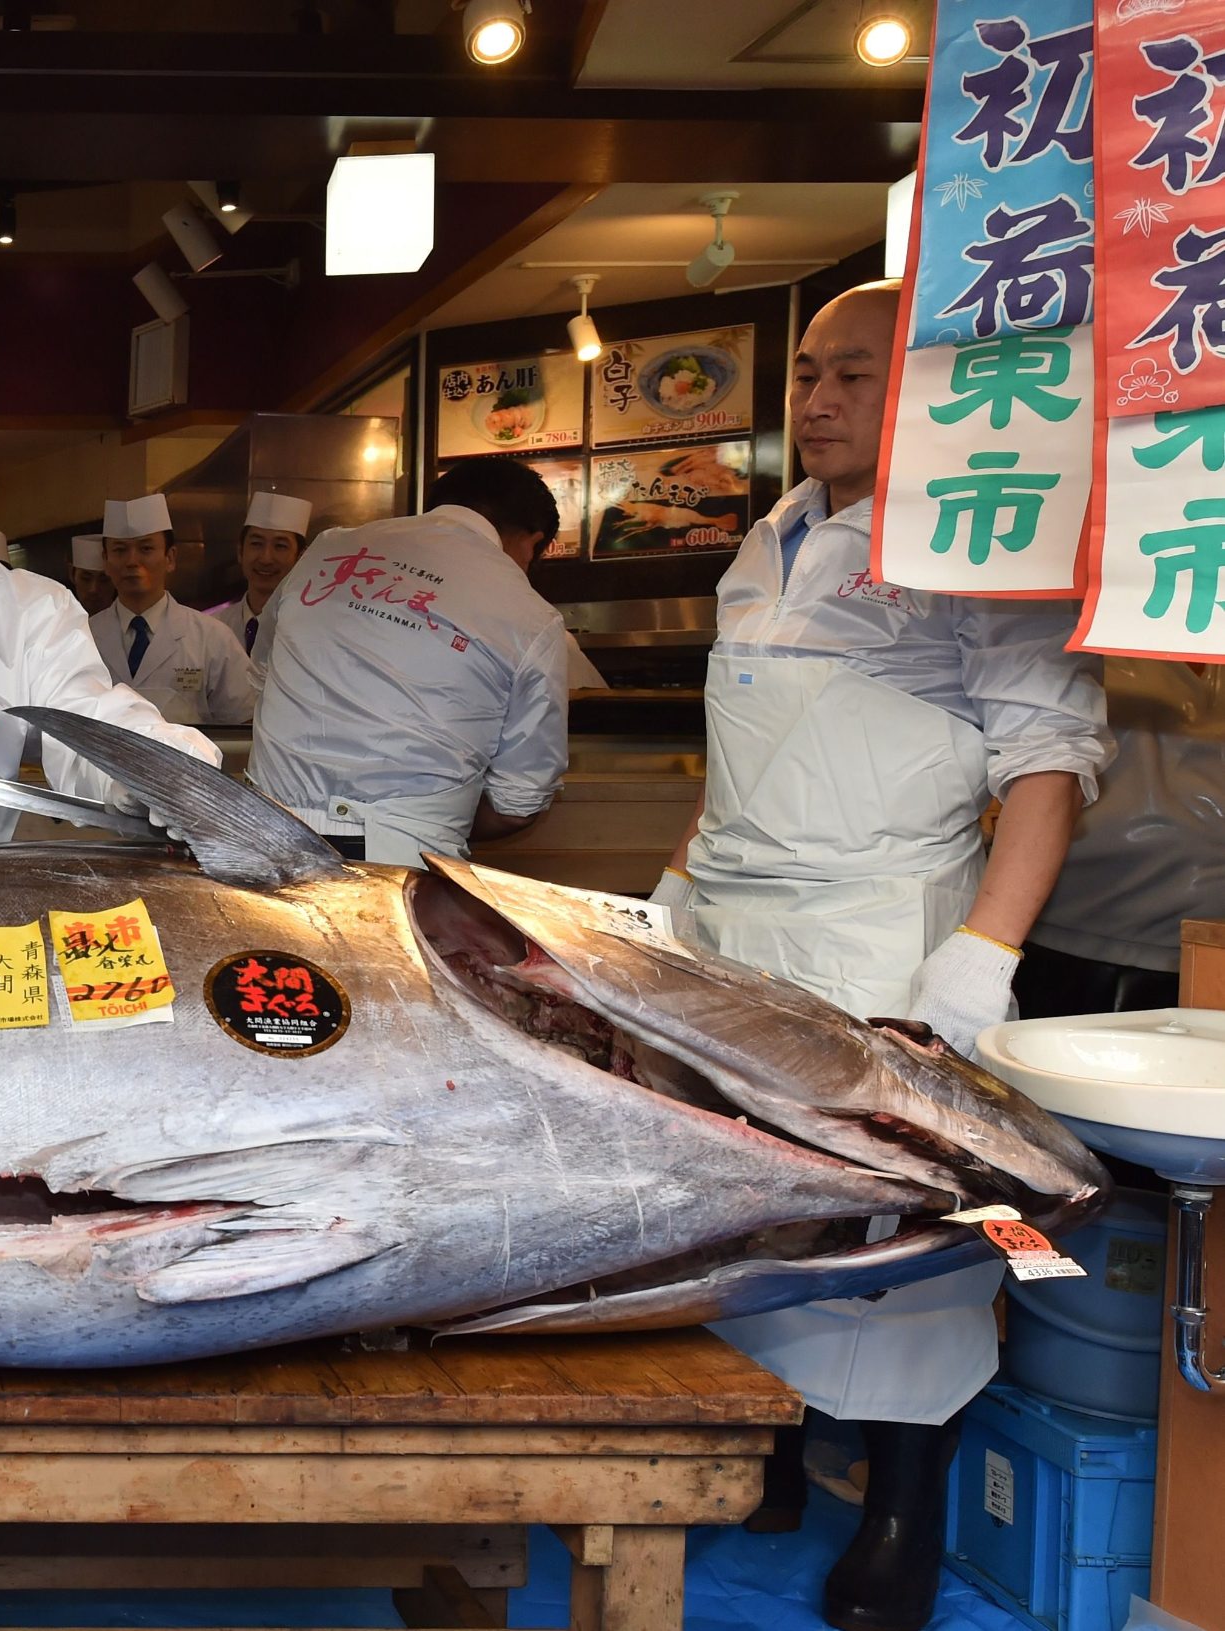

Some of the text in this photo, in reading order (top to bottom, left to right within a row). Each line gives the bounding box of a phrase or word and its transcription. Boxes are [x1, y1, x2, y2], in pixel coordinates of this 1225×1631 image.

[934, 16, 1093, 338] 初荷
[476, 365, 537, 394] あん肝
[603, 350, 640, 412] 白子
[927, 326, 1082, 566] 東市
[348, 601, 422, 631] SUSHIZANMAI
[21, 941, 45, 1005] 青森県
[232, 958, 314, 994] 大間
[236, 985, 320, 1017] まぐろ
